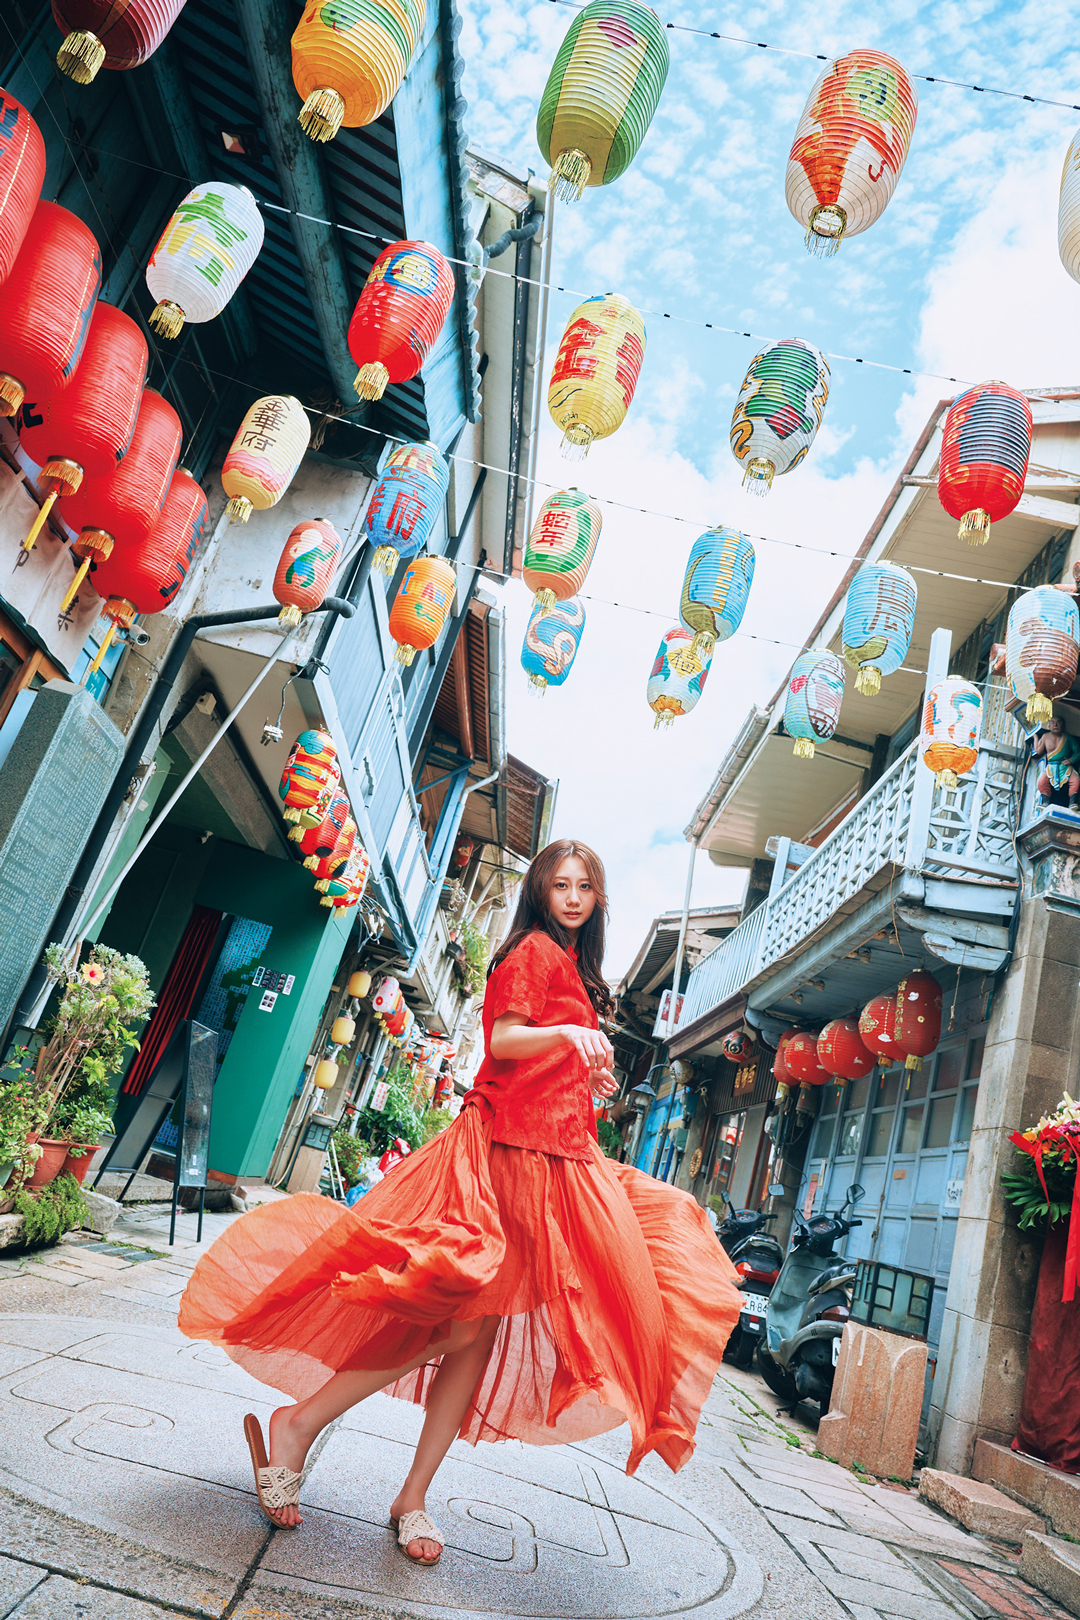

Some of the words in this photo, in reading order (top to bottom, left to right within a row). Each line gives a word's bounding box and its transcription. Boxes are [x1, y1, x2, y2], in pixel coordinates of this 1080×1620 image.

[241, 397, 290, 452] 金華府
[535, 511, 569, 546] 蛇年
[724, 1037, 745, 1055] 福
